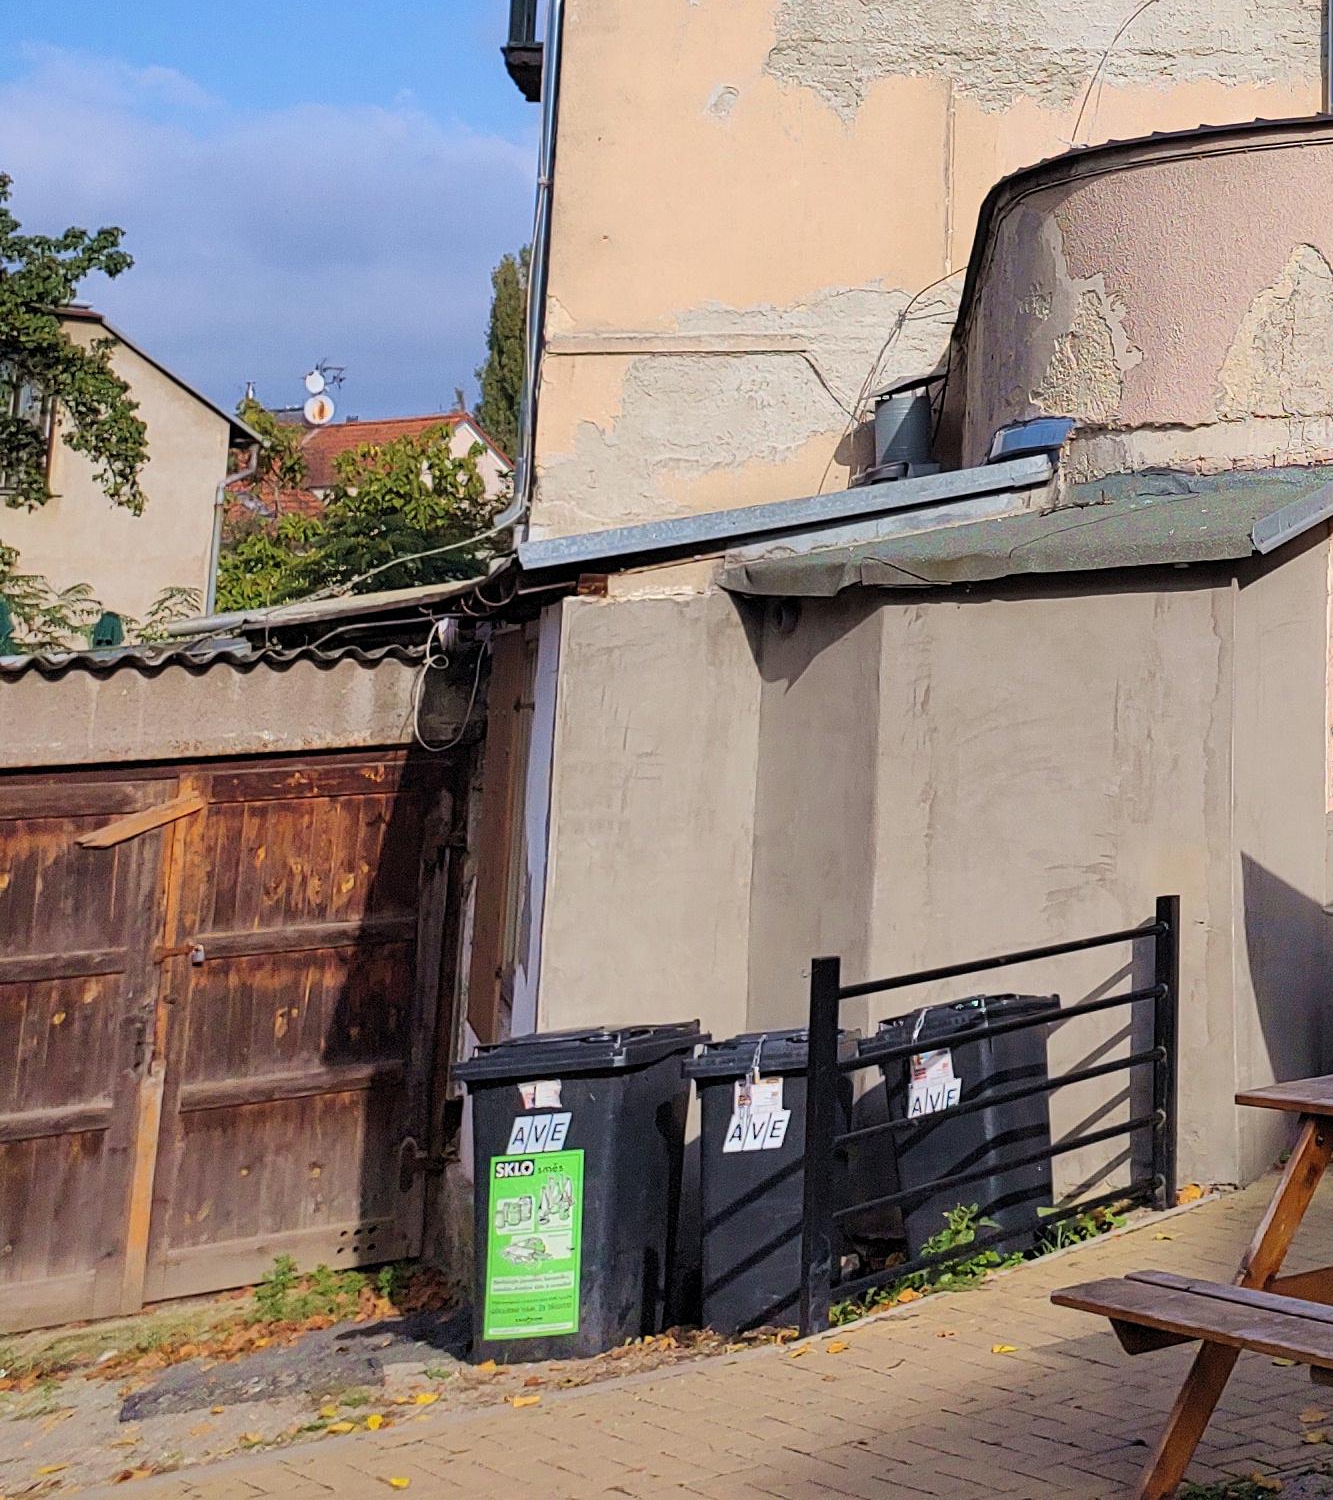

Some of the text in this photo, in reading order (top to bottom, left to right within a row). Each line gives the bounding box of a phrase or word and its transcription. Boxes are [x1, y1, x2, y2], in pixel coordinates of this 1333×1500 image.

[512, 1123, 566, 1145] AVE
[729, 1119, 785, 1142] AVE
[495, 1160, 534, 1178] SKLO
